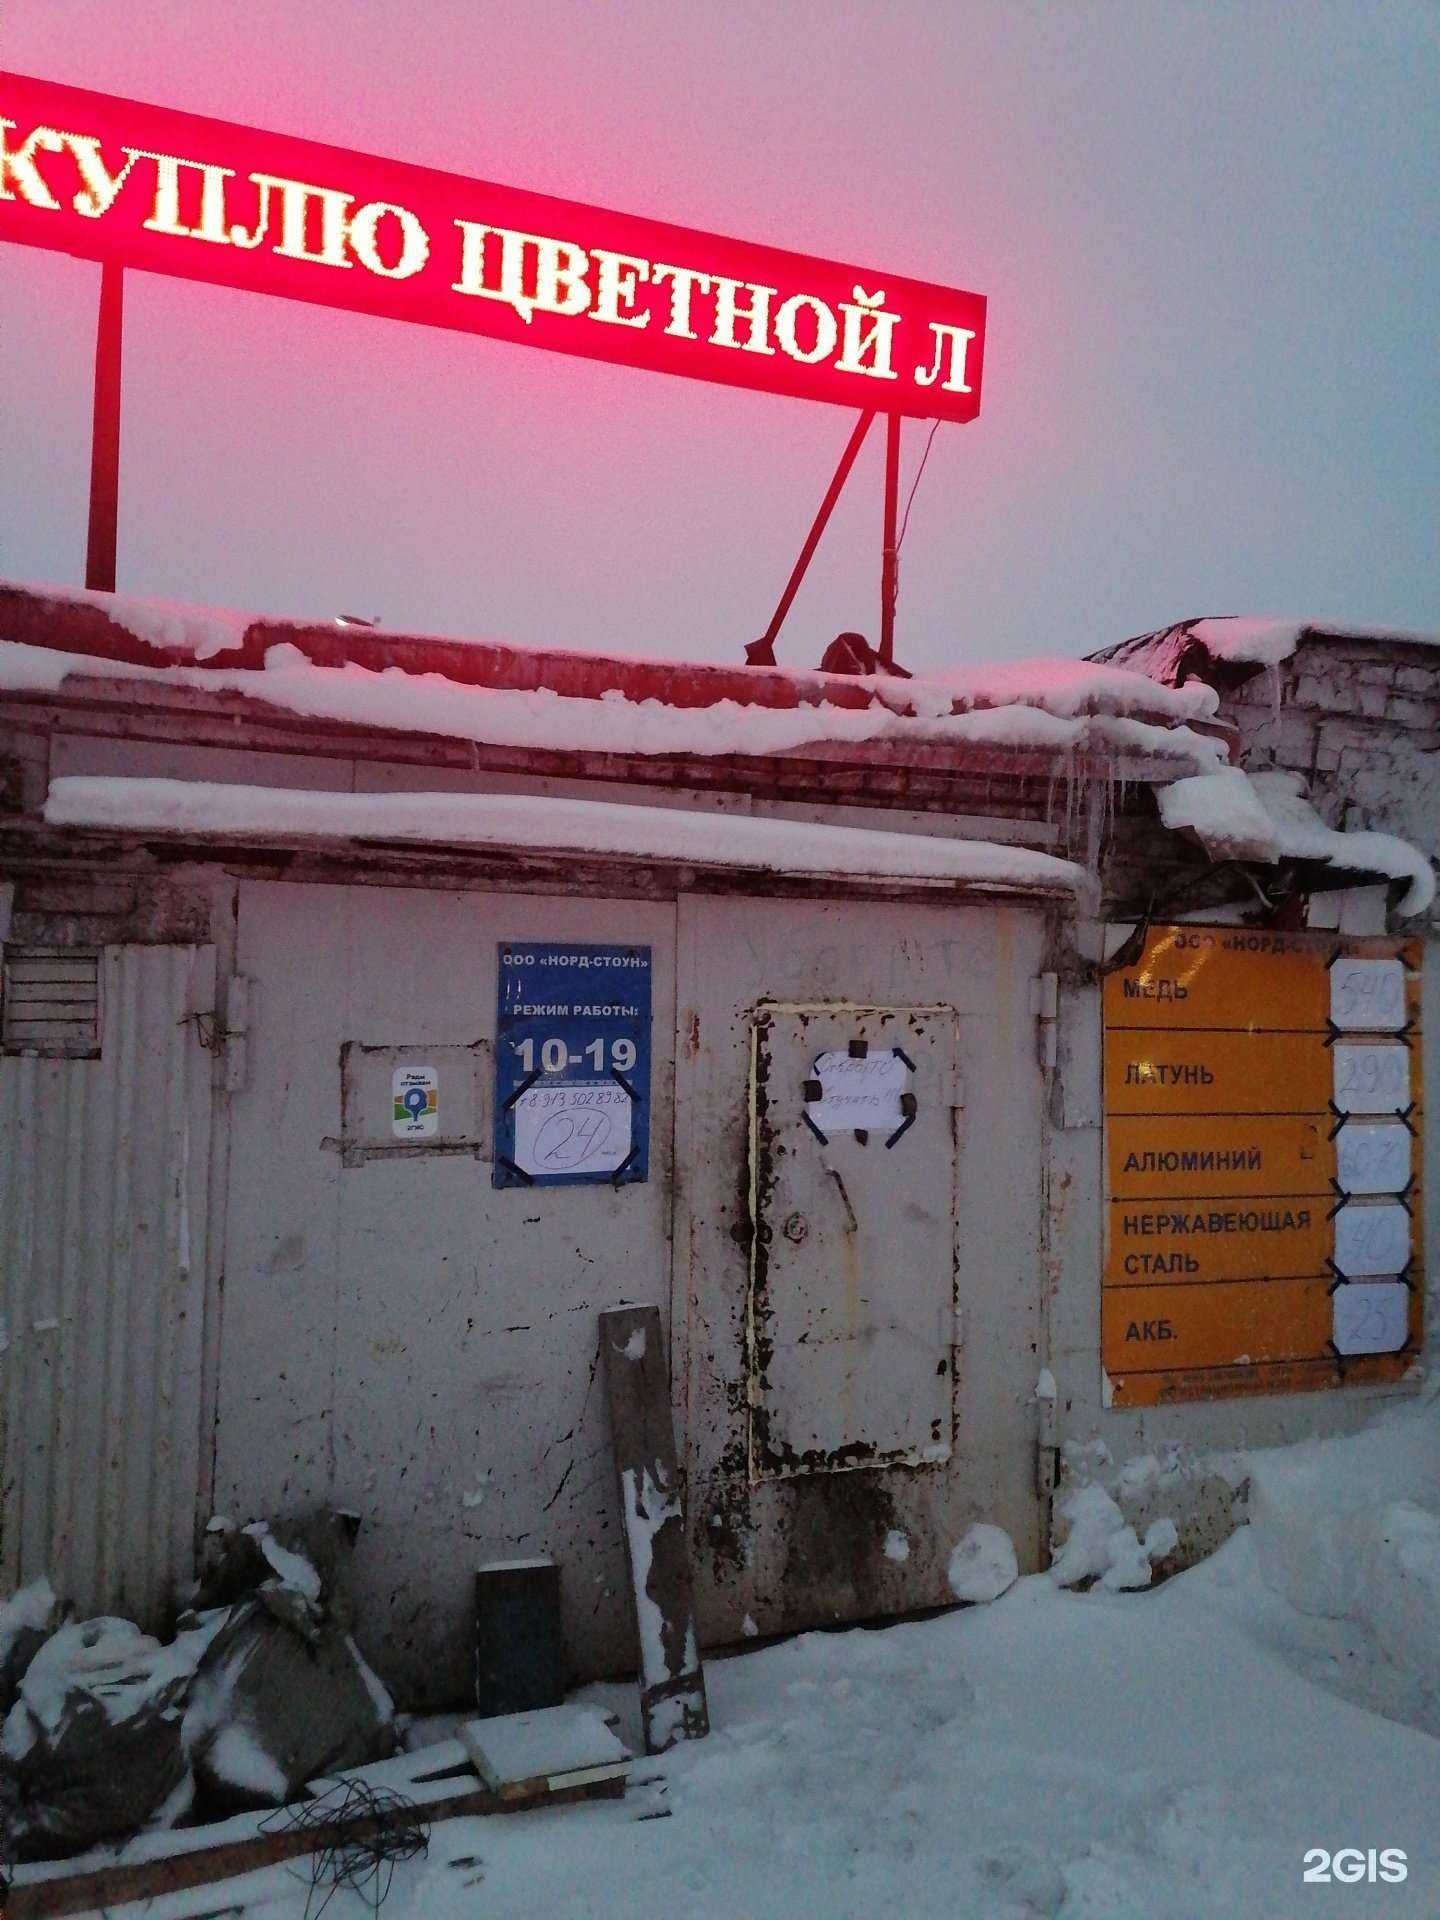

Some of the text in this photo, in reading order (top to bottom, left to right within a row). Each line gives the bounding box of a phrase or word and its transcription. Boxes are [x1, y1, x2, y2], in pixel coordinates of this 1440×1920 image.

[0, 117, 976, 394] КУПЛЮ ЦВЕТНОЙ Л
[503, 954, 648, 968] ООО «НОРД-СТОУН»
[1122, 977, 1189, 1001] МЕДЬ
[513, 1004, 639, 1017] РЕЖИМ РАБОТЫ:
[515, 1038, 637, 1072] 10-19
[1124, 1063, 1215, 1085] ЛАТУНЬ
[544, 1117, 605, 1161] 24
[1123, 1147, 1262, 1172] АЛЮМИНИЙ
[1124, 1210, 1312, 1235] НЕРЖАВЕЮЩАЯ
[1124, 1254, 1200, 1275] СТАЛЬ
[1125, 1319, 1179, 1342] АКБ.
